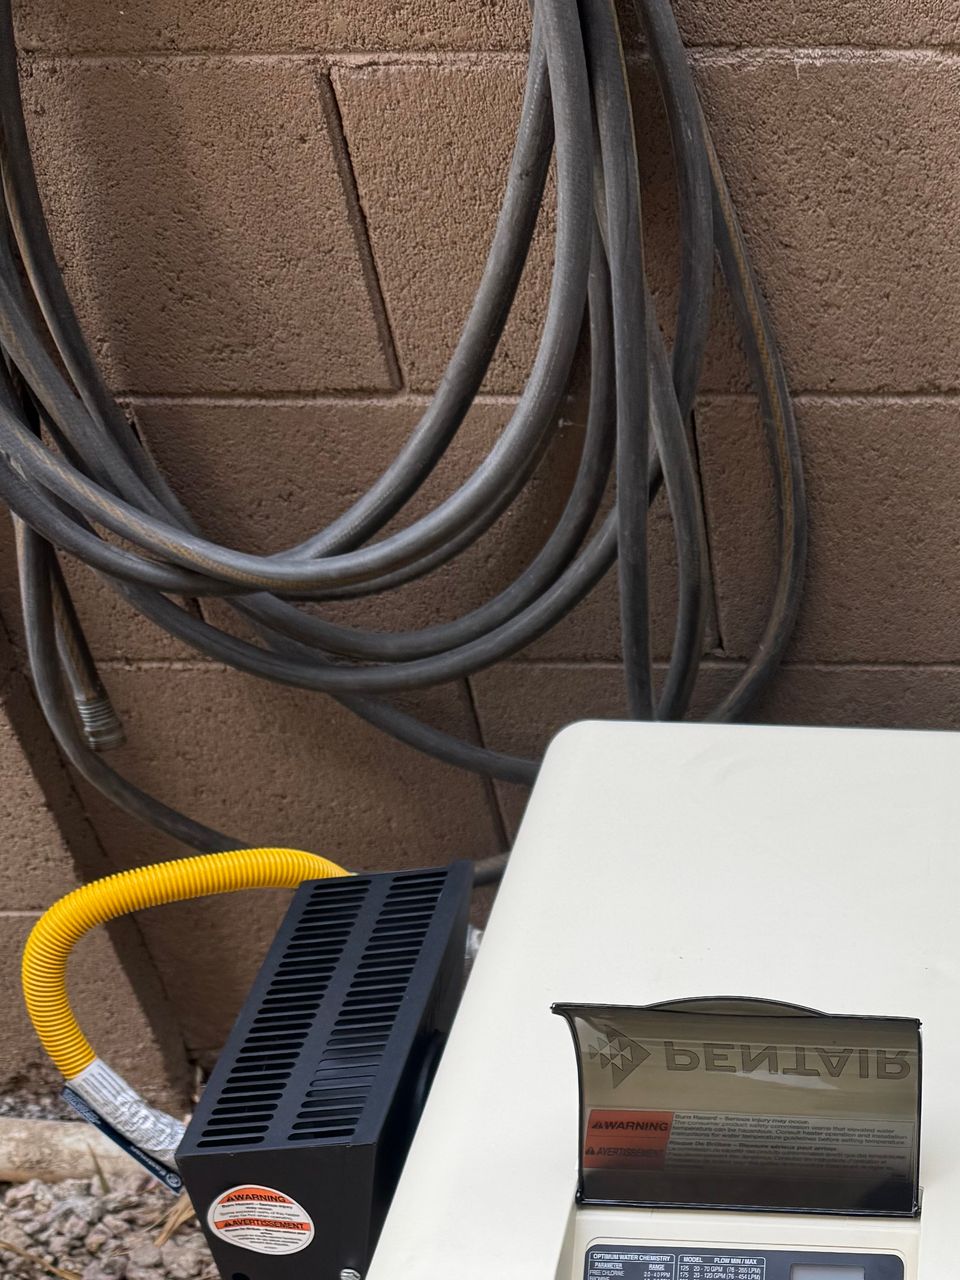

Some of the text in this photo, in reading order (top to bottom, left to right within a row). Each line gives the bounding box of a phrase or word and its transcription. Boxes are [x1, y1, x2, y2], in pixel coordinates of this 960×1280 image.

[605, 1120, 668, 1132] WARNING
[234, 1194, 286, 1202] WARNING
[233, 1218, 303, 1229] AVERTISSEMENT
